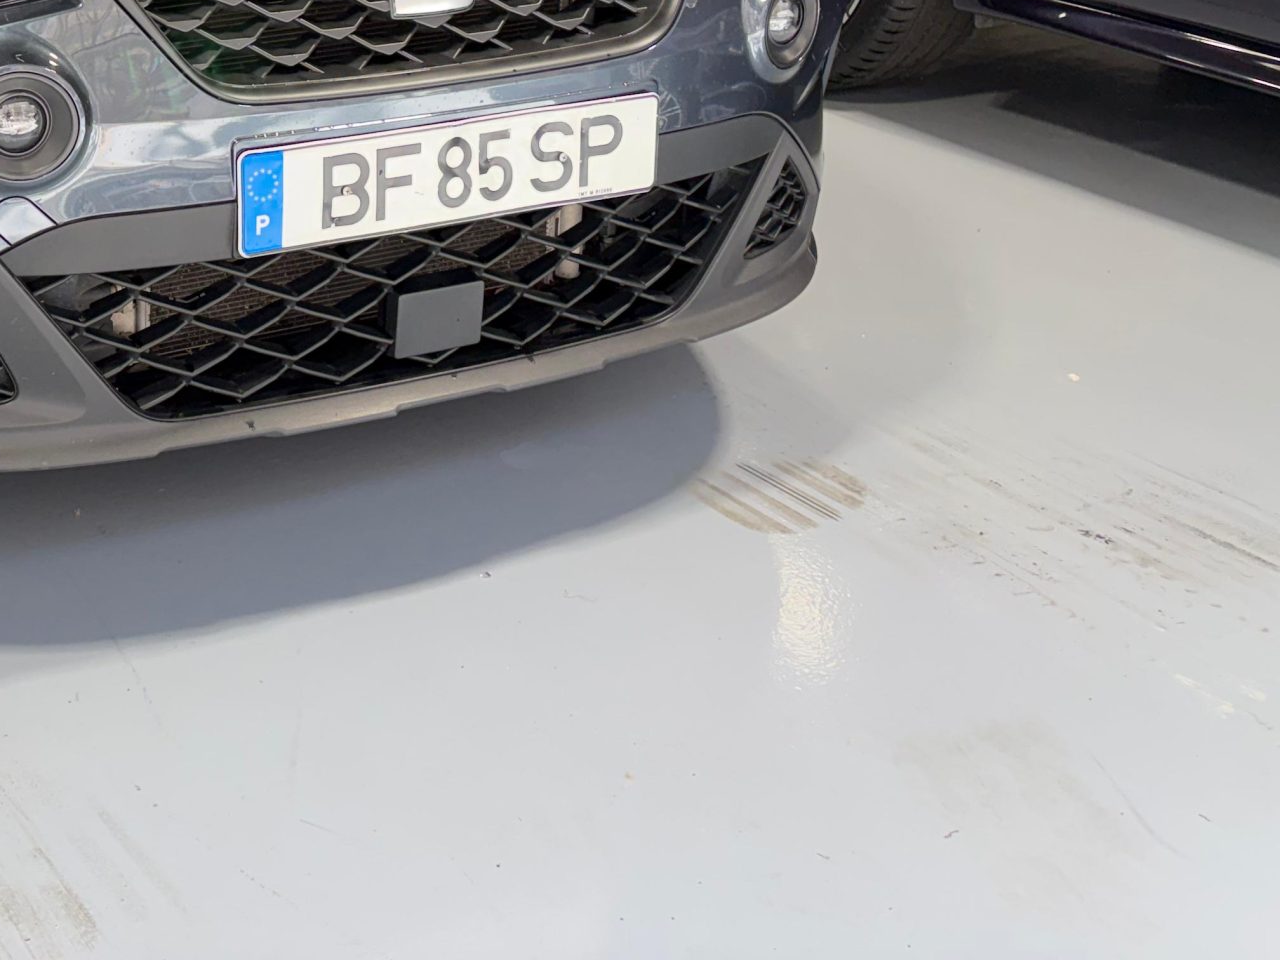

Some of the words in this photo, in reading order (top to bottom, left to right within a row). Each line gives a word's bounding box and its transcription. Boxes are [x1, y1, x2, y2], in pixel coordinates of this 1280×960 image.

[322, 142, 422, 230] BF
[438, 129, 513, 208] 85
[530, 114, 623, 193] SP
[255, 214, 271, 237] P
